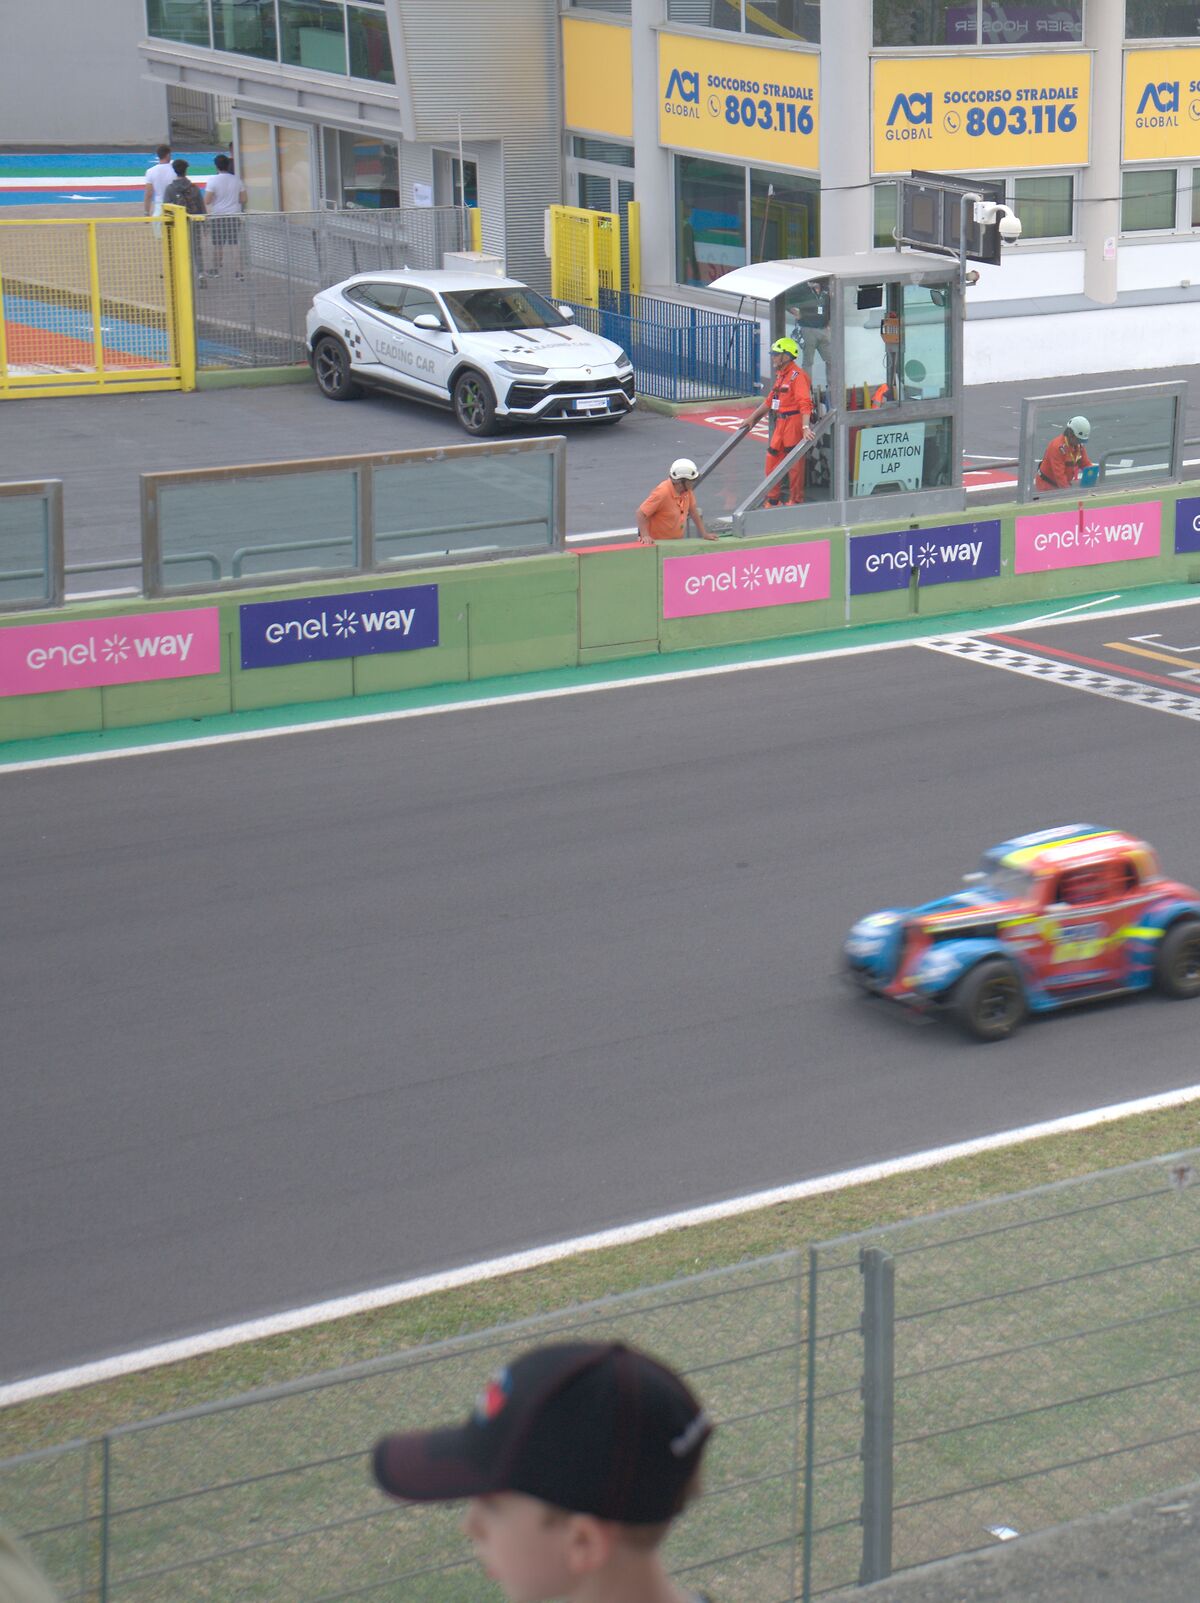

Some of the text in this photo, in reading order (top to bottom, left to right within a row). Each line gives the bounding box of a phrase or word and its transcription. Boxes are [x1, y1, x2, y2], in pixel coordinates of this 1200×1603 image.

[665, 68, 699, 104] ACI
[707, 75, 814, 101] SOCCORSO STRADALE
[943, 87, 1079, 104] SOCCORSO STRADALE
[1136, 81, 1179, 114] ACI
[665, 102, 700, 119] GLOBAL
[725, 95, 814, 135] 803.116
[886, 92, 933, 126] ACI
[966, 104, 1077, 137] 803.116
[1135, 116, 1179, 128] GLOBAL
[885, 128, 933, 141] GLOBAL
[376, 340, 435, 374] LEADING CAR
[862, 445, 921, 461] FORMATION
[876, 432, 910, 445] EXTRA
[881, 462, 901, 474] LAP
[1034, 522, 1145, 551] enel way
[865, 541, 983, 573] enel way
[685, 563, 811, 595] enel way
[265, 608, 416, 644] enel way
[26, 633, 193, 669] enel way
